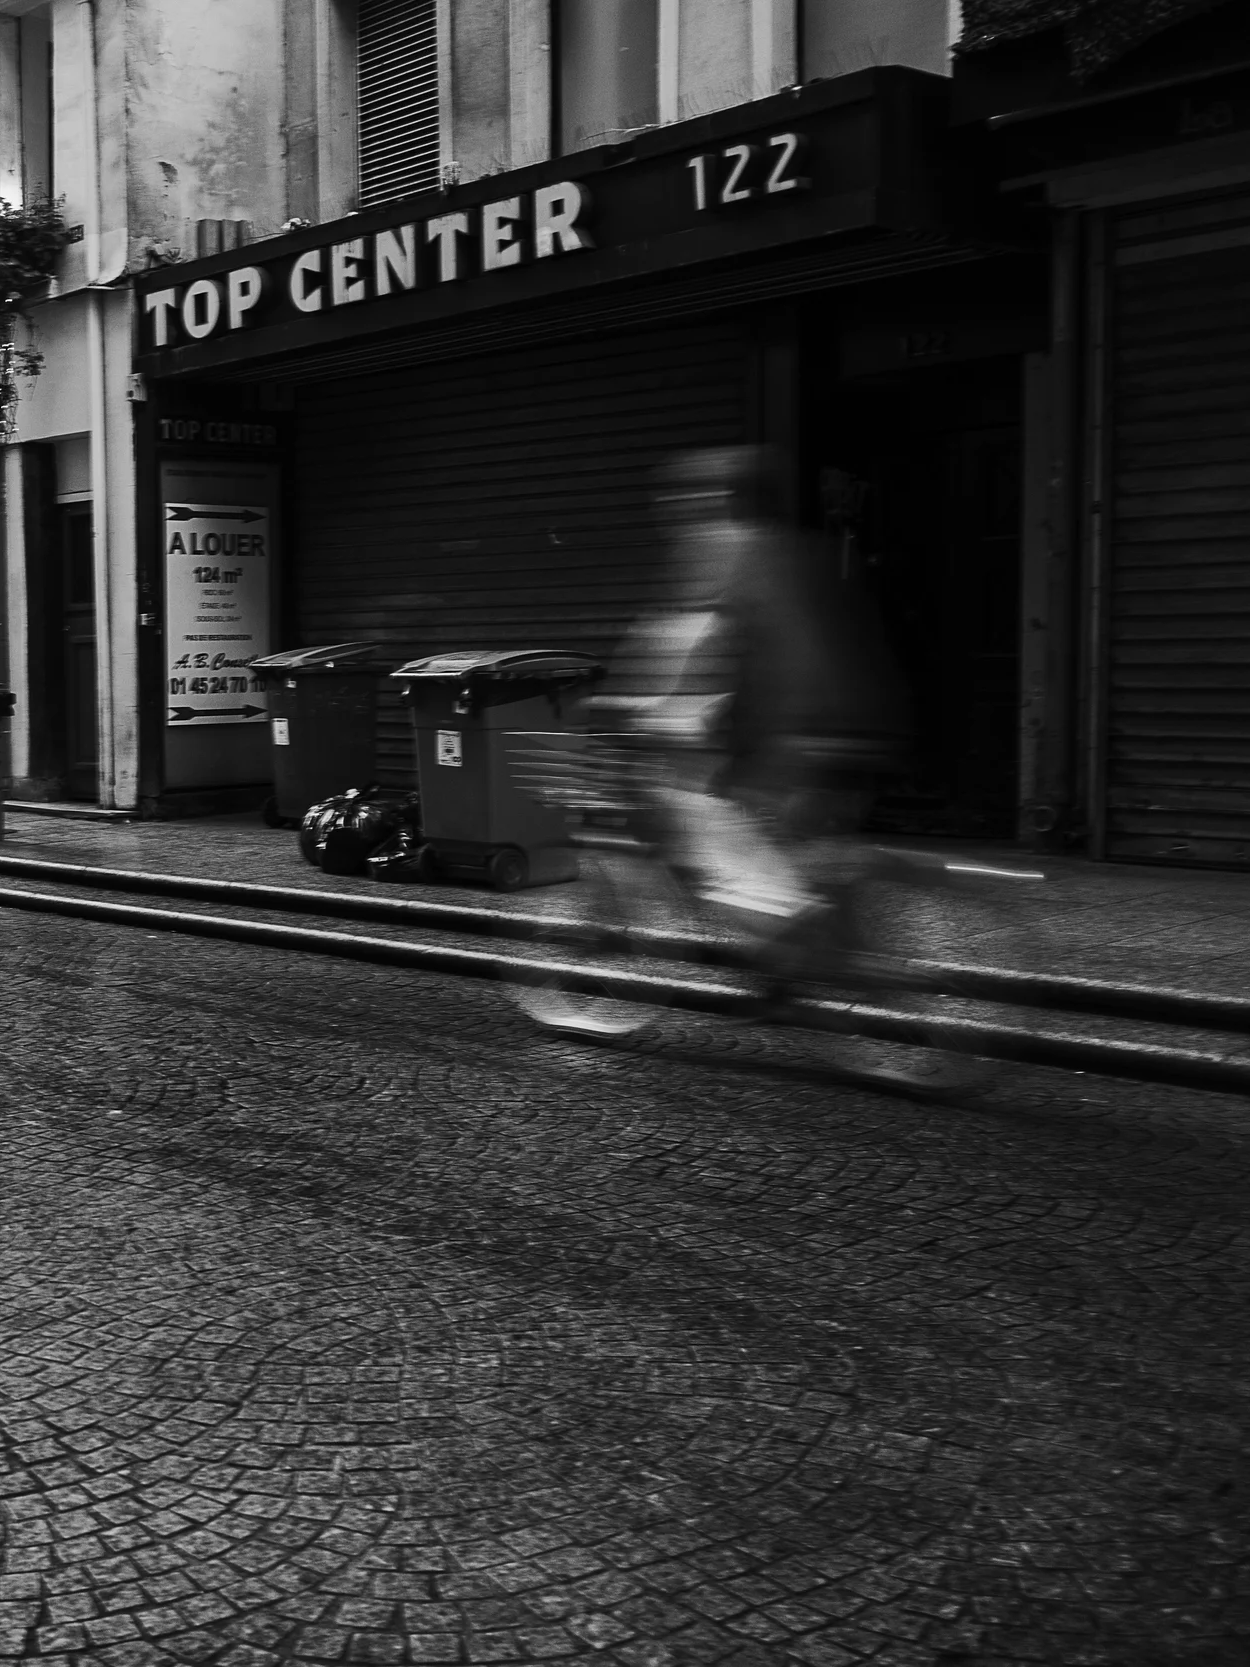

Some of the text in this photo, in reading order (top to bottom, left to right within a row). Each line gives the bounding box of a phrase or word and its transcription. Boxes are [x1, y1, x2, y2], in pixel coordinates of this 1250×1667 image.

[146, 133, 798, 347] TOP CENTER 122
[158, 418, 277, 446] TOP CENTER
[168, 532, 266, 556] A LOUER
[192, 567, 220, 583] 124
[170, 677, 187, 694] 01
[189, 677, 209, 694] 45
